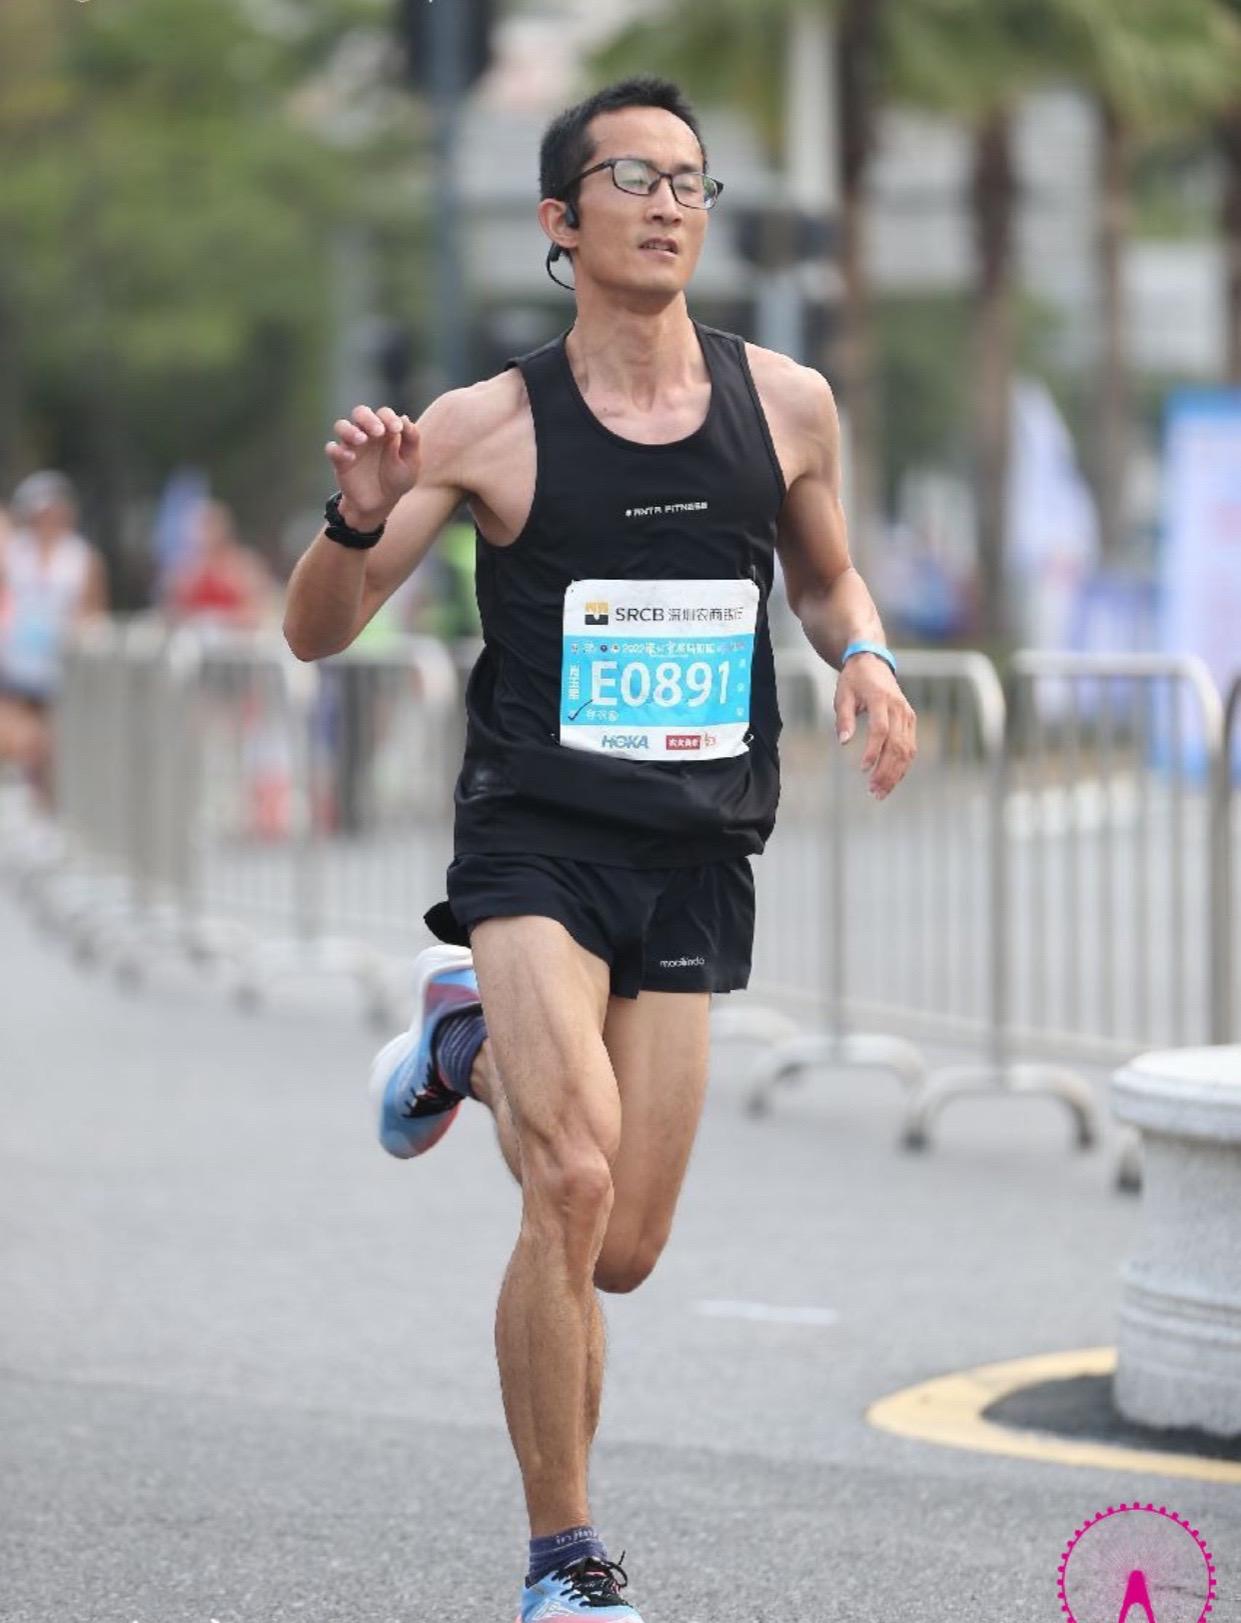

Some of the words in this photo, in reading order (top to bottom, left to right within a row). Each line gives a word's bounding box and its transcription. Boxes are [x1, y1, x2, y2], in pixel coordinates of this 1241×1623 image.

[615, 607, 665, 622] SRCB
[591, 660, 731, 708] E0891
[601, 734, 650, 750] HOKA
